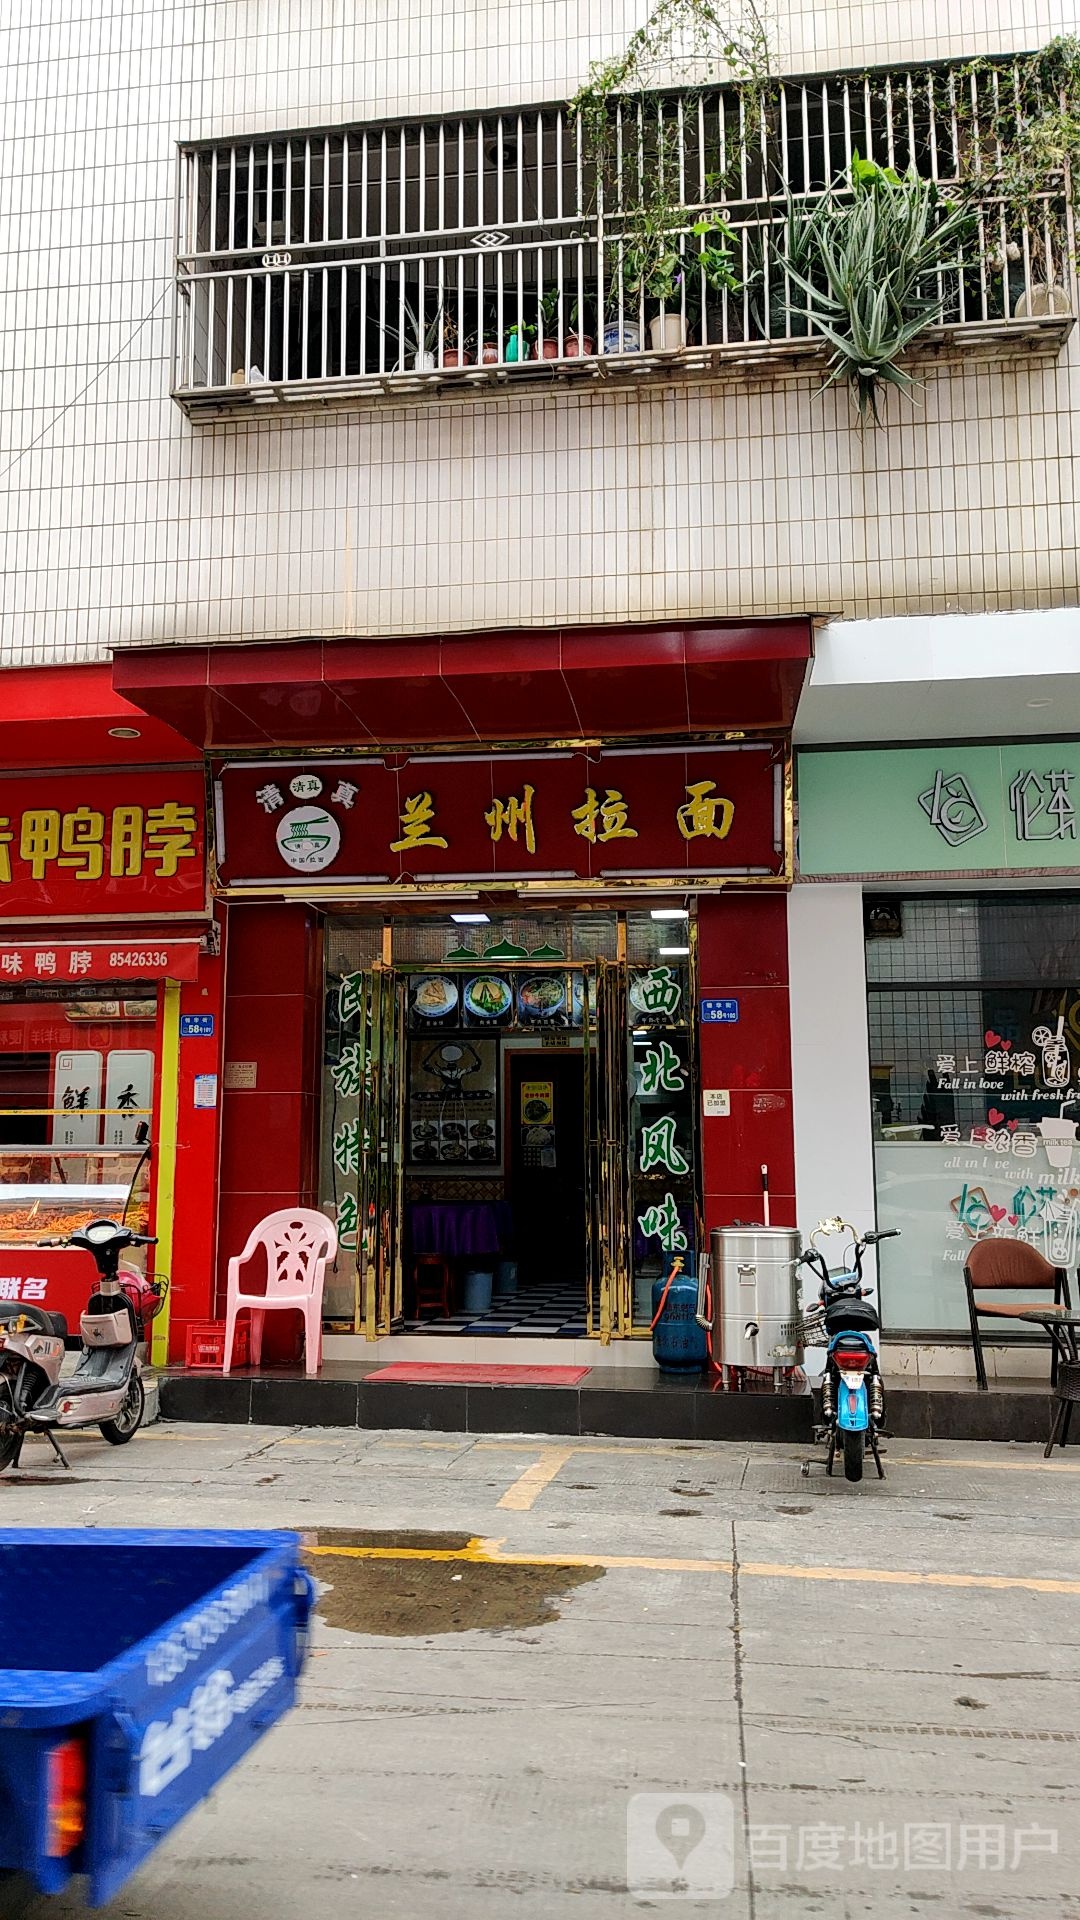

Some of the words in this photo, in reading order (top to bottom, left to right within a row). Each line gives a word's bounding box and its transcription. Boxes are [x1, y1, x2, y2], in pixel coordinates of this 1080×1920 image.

[292, 779, 320, 793] 清真
[389, 781, 735, 855] 兰州拉面
[1, 951, 92, 976] 味鸭脖
[109, 952, 168, 967] 85426336
[936, 1050, 1036, 1076] 爱上鲜榨
[937, 1078, 957, 1090] Fall
[963, 1078, 976, 1089] in
[979, 1077, 1004, 1090] love
[1001, 1089, 1028, 1101] with
[1031, 1088, 1063, 1101] fresh
[638, 966, 689, 1252] 西北风味
[940, 1124, 1038, 1158] 爱上浓香
[1043, 1138, 1059, 1146] milk
[1005, 1168, 1034, 1180] with
[1038, 1168, 1080, 1185] milk
[943, 1250, 965, 1261] Fall
